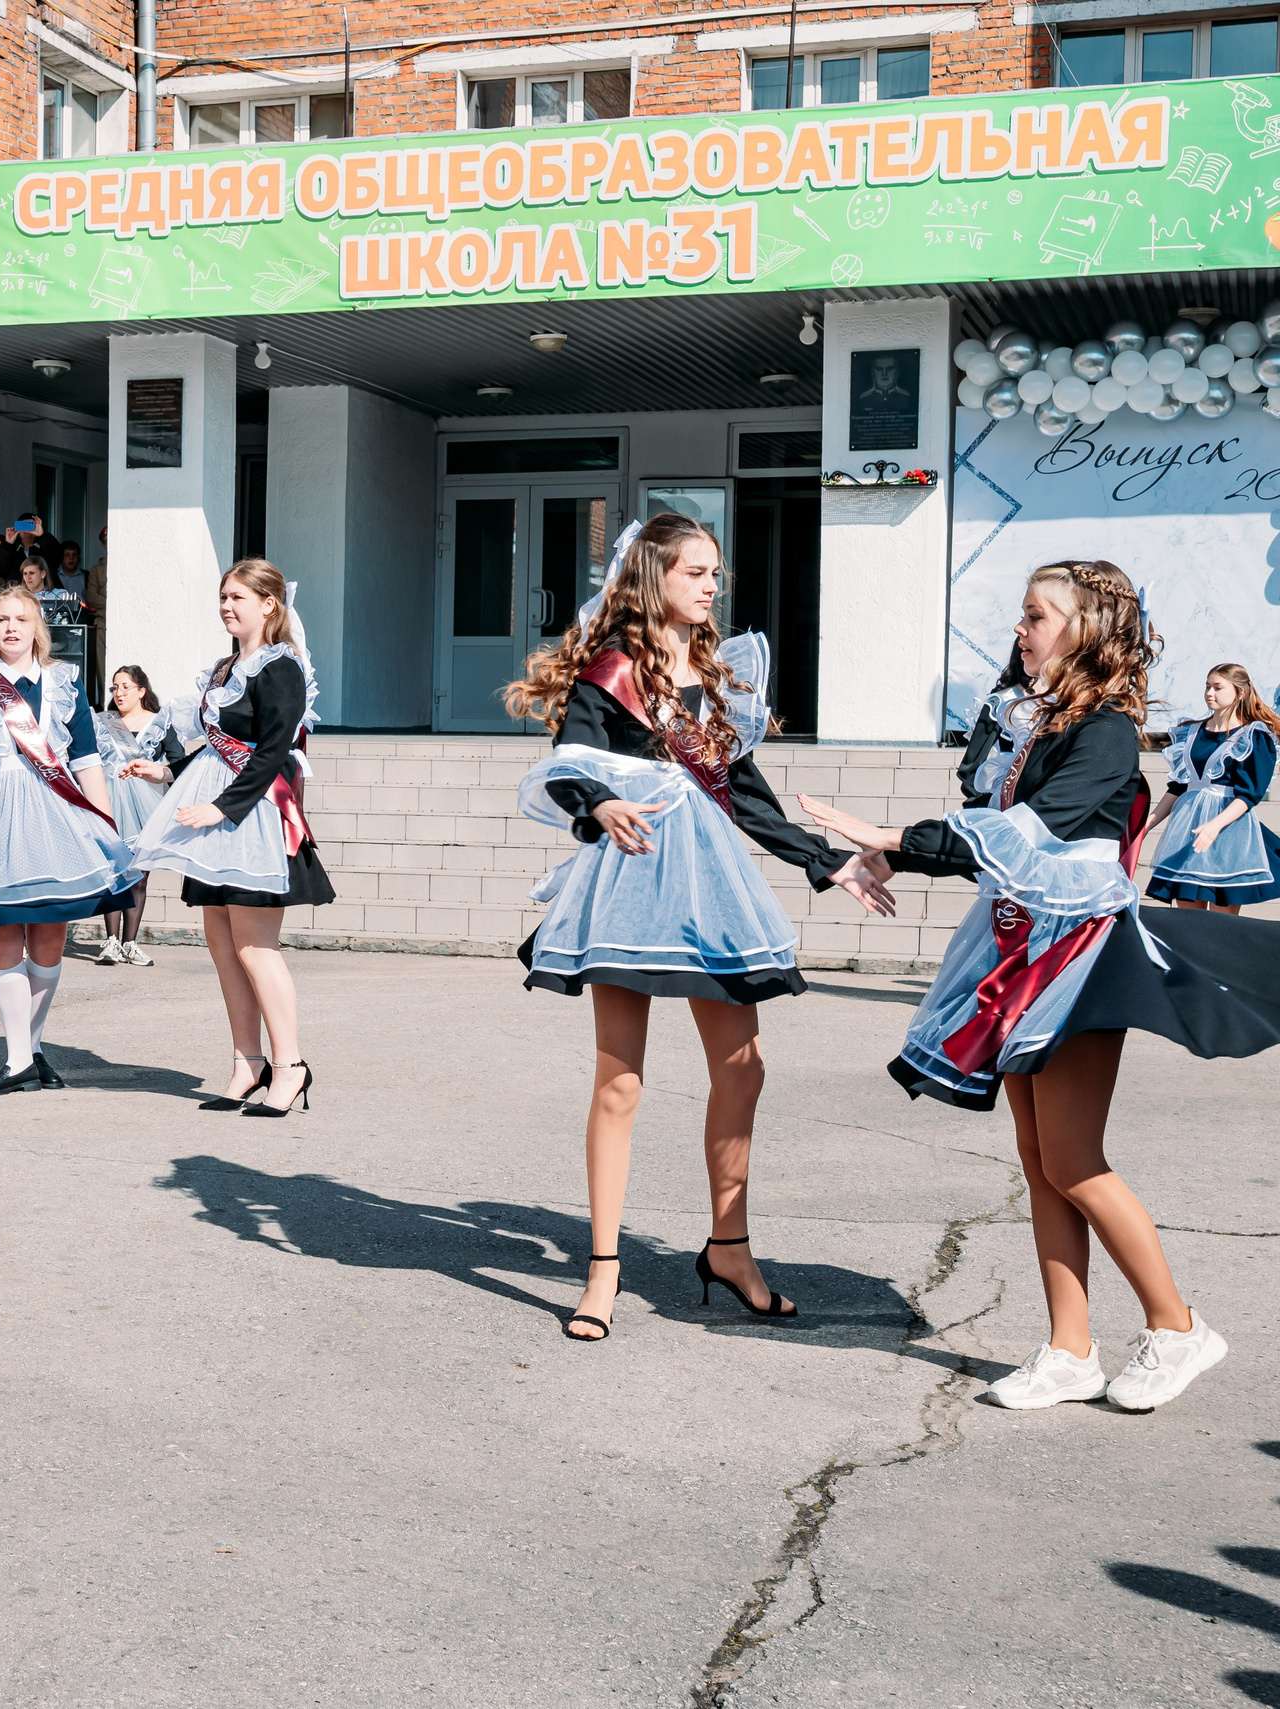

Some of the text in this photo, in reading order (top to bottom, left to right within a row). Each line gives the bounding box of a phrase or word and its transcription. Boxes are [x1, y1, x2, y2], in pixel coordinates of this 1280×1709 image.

[15, 97, 1170, 237] СРЕДНЯЯ ОБЩЕОБРАЗОВАТЕЛЬНАЯ
[340, 203, 757, 299] ШКОЛА №31
[1026, 420, 1243, 501] Выпуск
